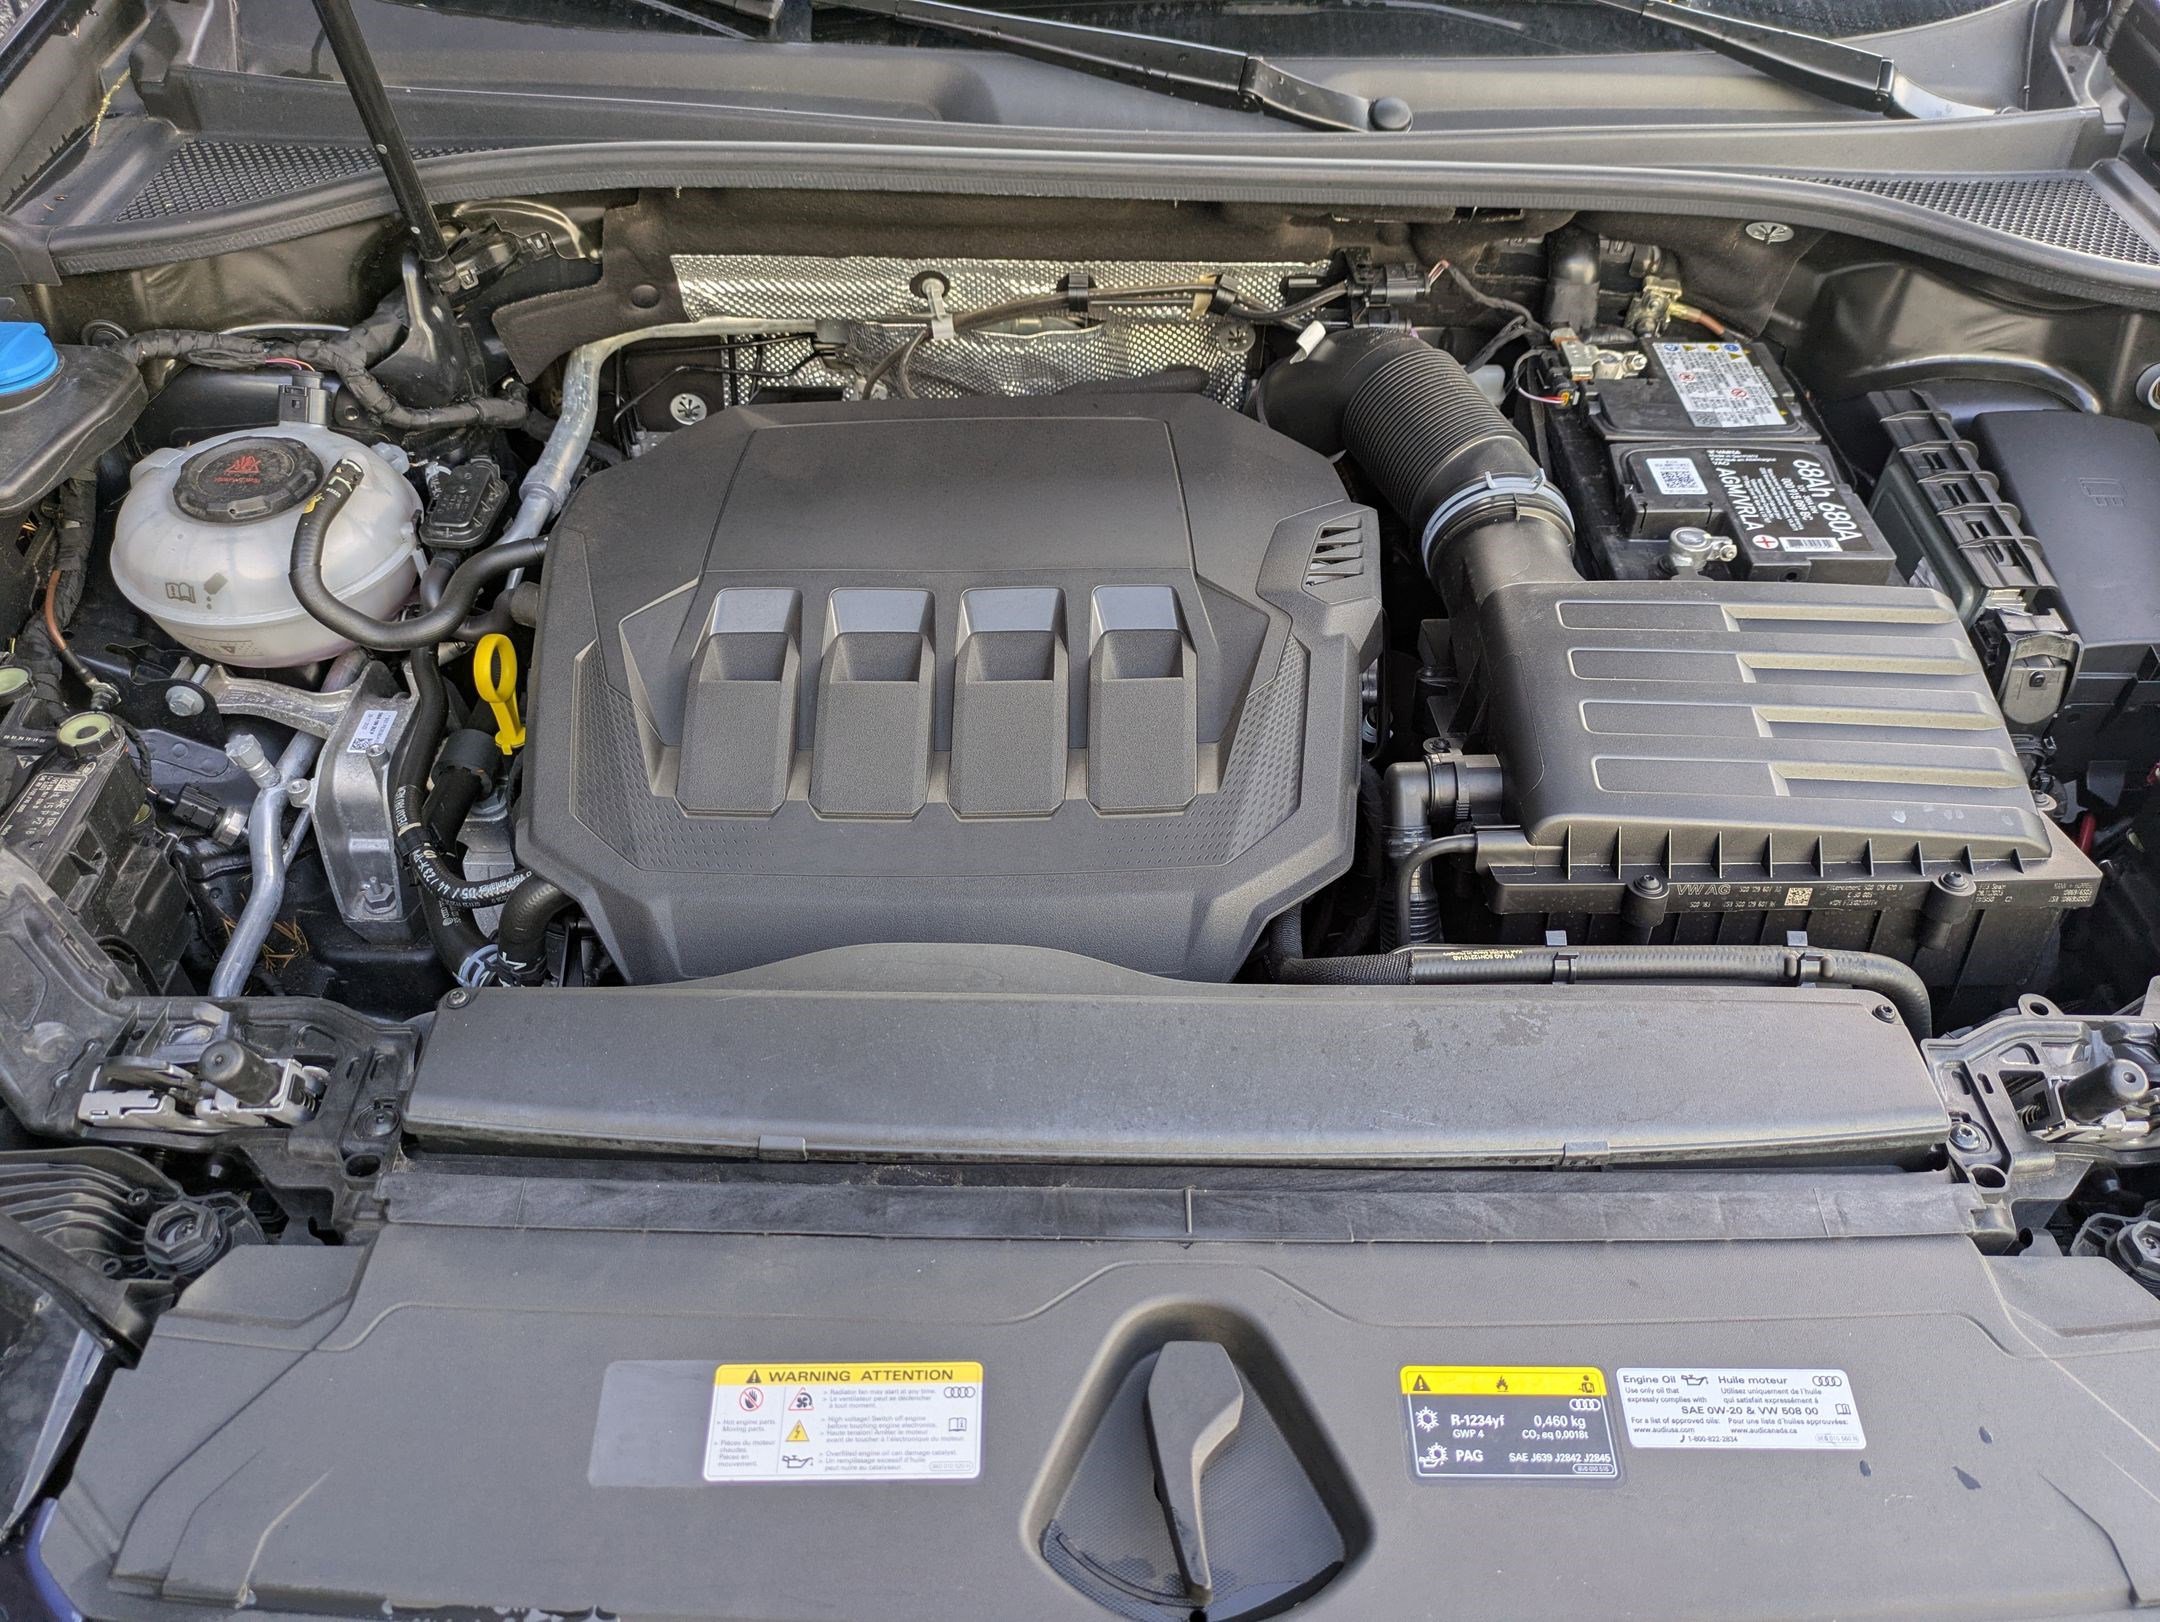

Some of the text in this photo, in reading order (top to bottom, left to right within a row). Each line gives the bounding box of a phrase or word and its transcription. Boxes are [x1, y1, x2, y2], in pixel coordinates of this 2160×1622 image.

[1715, 467, 1765, 531] AGM/VRLA
[1793, 459, 1863, 542] 68Ah 680A
[1676, 884, 1704, 896] VW
[1704, 883, 1731, 896] AG
[769, 1369, 953, 1382] WARNING ATTENTION
[1622, 1375, 1676, 1384] Engine Oil
[1718, 1375, 1787, 1384] Huile moteur
[1640, 1387, 1655, 1395] only
[1747, 1387, 1788, 1395] uniquement
[1627, 1396, 1659, 1404] expressly
[1660, 1396, 1691, 1404] complies
[1681, 1406, 1819, 1415] SAE 0W-20 & VW 508 00
[1450, 1414, 1586, 1429] R-1234yf 0,460 kg
[1671, 1417, 1704, 1425] approved
[1452, 1429, 1476, 1439] GWP
[1477, 1429, 1485, 1439] 4
[1542, 1432, 1554, 1440] eq
[1455, 1449, 1611, 1463] PAG SAE J639 J2842 J2845
